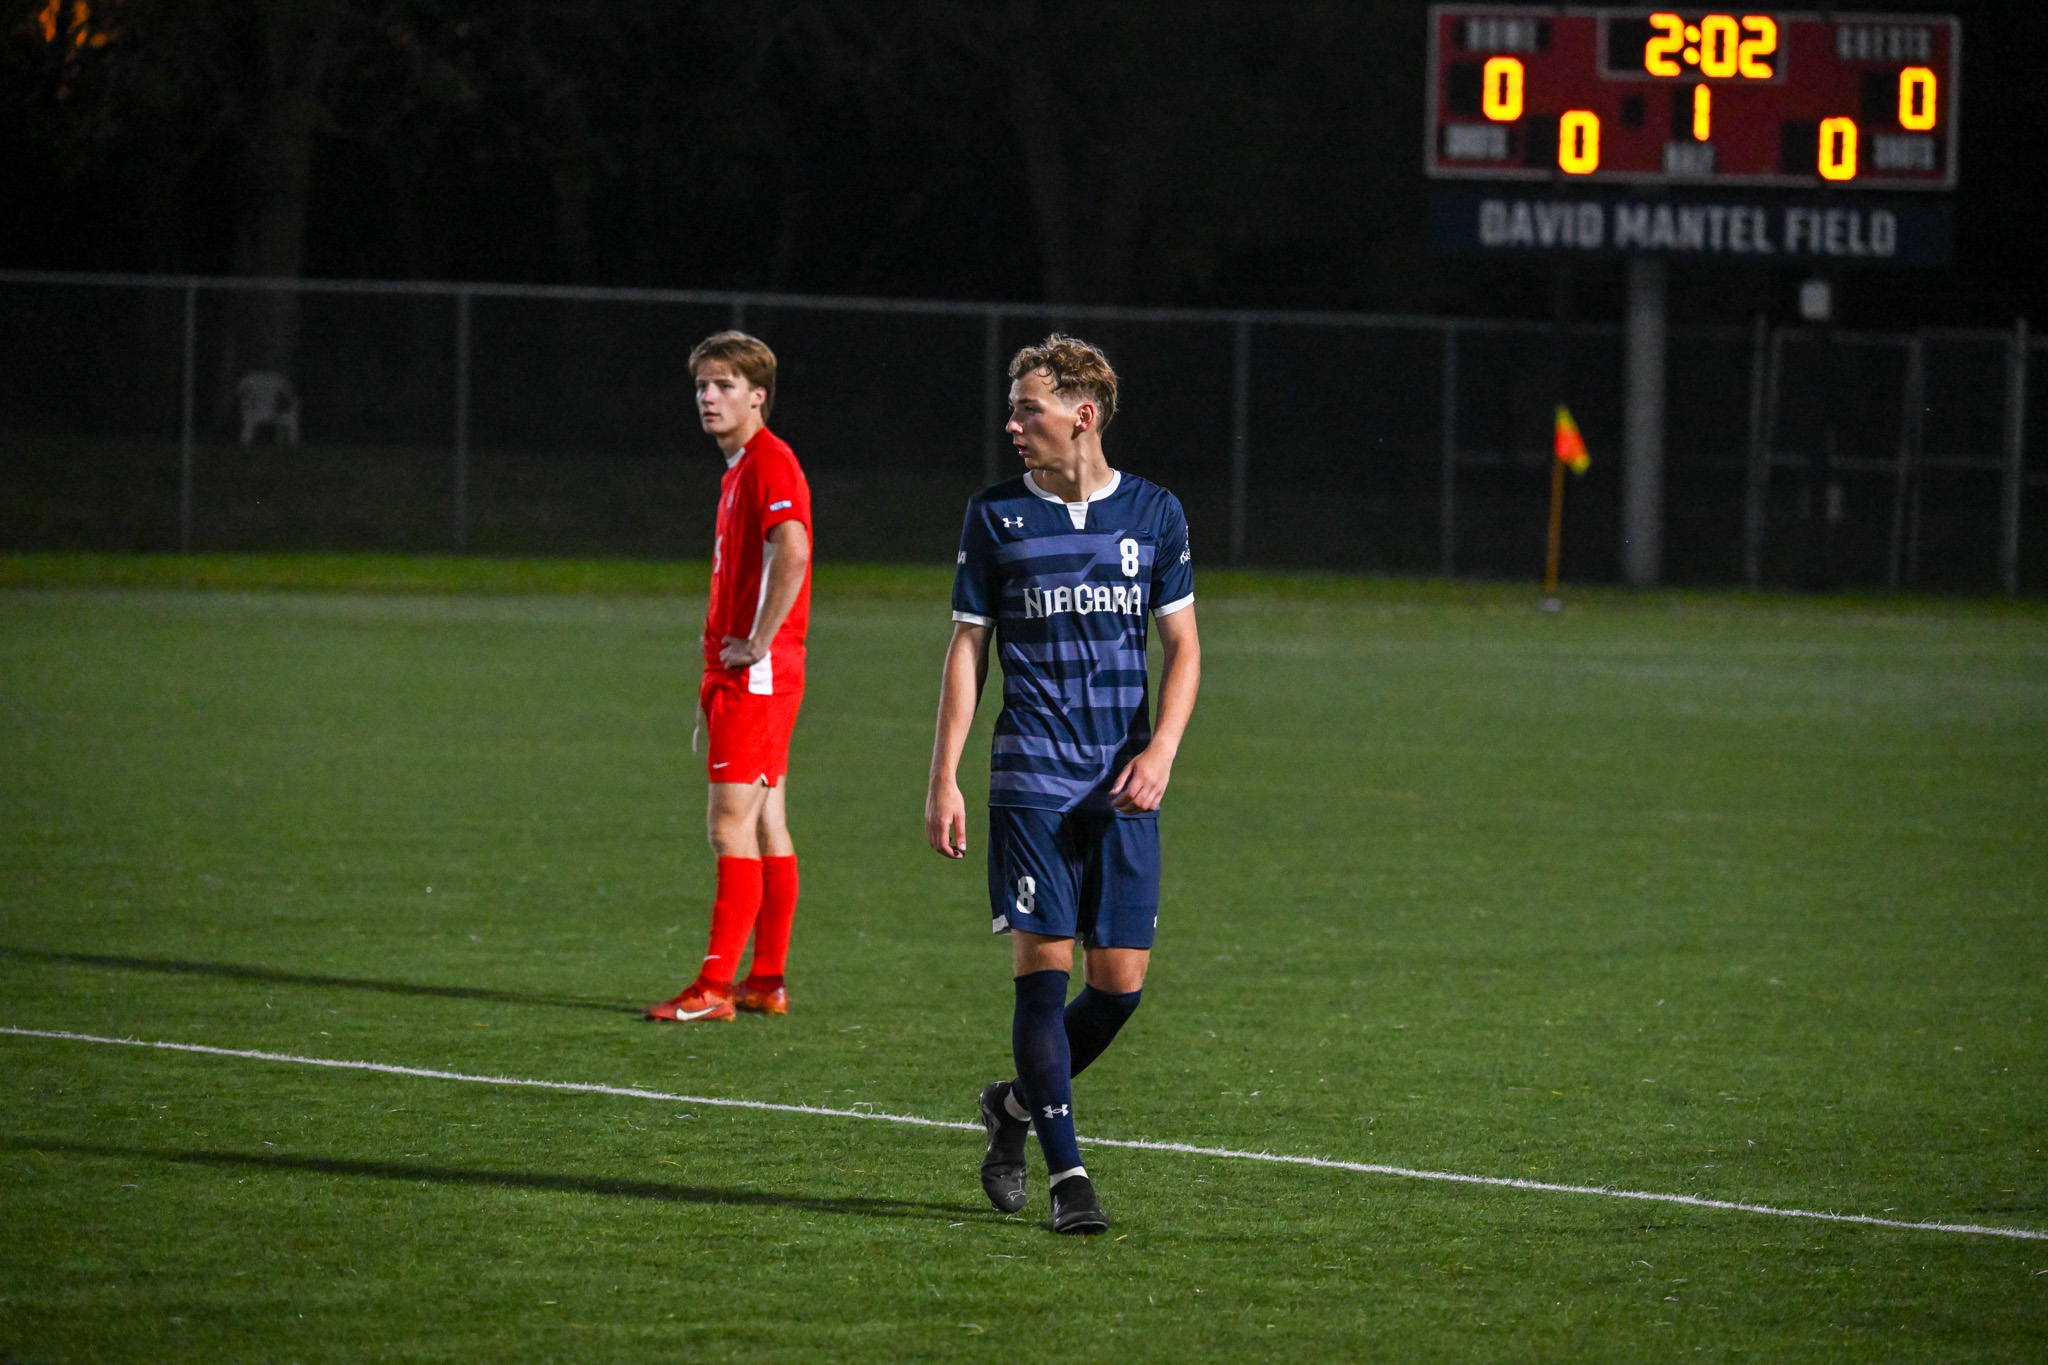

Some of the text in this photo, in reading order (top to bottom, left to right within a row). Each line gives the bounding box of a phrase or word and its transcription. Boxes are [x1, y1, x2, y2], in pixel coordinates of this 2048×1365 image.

[1644, 13, 1777, 79] 2:02
[1482, 57, 1524, 122] 0
[1693, 83, 1711, 142] 1
[1898, 66, 1937, 131] 0
[1558, 110, 1600, 175] 0
[1818, 116, 1858, 181] 0
[1479, 202, 1896, 256] DAVID MANTEL FIELD
[1120, 538, 1139, 577] 8
[1024, 583, 1142, 617] NIAGARA
[1016, 875, 1036, 914] 8
